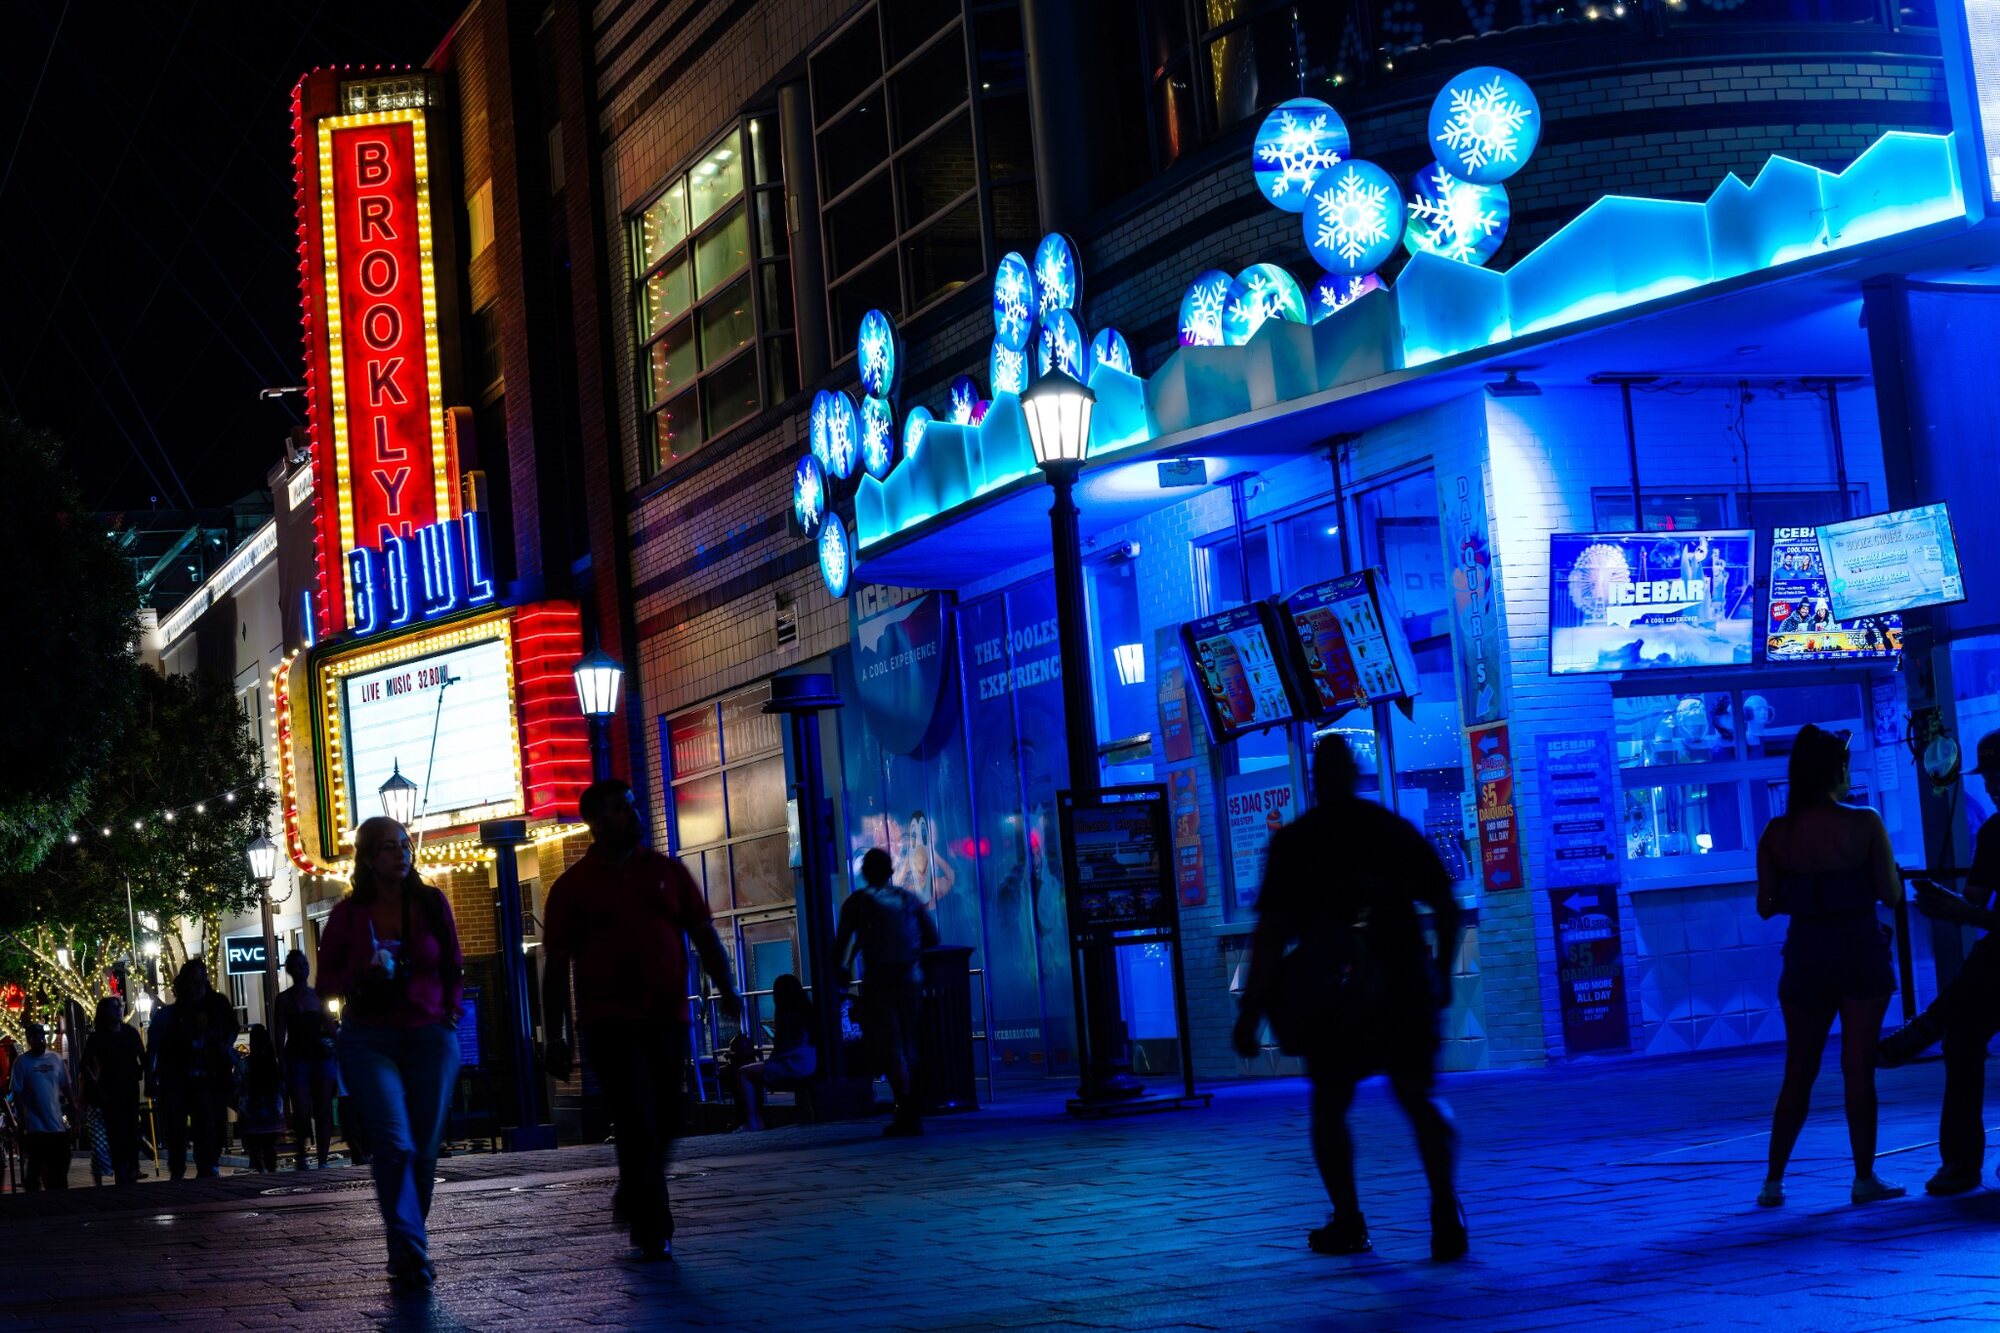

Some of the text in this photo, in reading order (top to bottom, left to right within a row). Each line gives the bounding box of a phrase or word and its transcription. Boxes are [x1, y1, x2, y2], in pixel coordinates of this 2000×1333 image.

[1774, 527, 1816, 539] ICEBA
[348, 511, 494, 634] BOWL
[1457, 476, 1486, 683] DAIQUIRIS
[1609, 580, 1704, 604] ICEBAR
[1650, 616, 1665, 624] COOL
[1665, 615, 1698, 623] EXPERIENCE
[974, 618, 1060, 667] THE COOLES
[861, 641, 937, 682] A COOL EXPERIENCE
[361, 682, 380, 703] LIVE
[386, 673, 412, 697] MUSIC
[417, 670, 428, 689] 32
[978, 655, 1061, 701] EXPERIENC
[1547, 739, 1596, 751] ICEBAR
[1229, 786, 1291, 815] $5 DAQ STOP
[1482, 783, 1498, 807] $5
[1479, 804, 1514, 822] DAIQUIRIS
[1486, 819, 1510, 831] AND MORE
[1488, 830, 1509, 842] ALL DAY
[1568, 917, 1592, 930] DAQ
[1592, 917, 1610, 928] STOP
[1576, 929, 1607, 940] ICEBAR
[229, 947, 266, 962] RVC
[1568, 943, 1595, 967] $5
[1561, 965, 1620, 983] DAIQUIRIS
[1573, 979, 1613, 991] AND MORE
[1577, 990, 1612, 1003] ALL DAY
